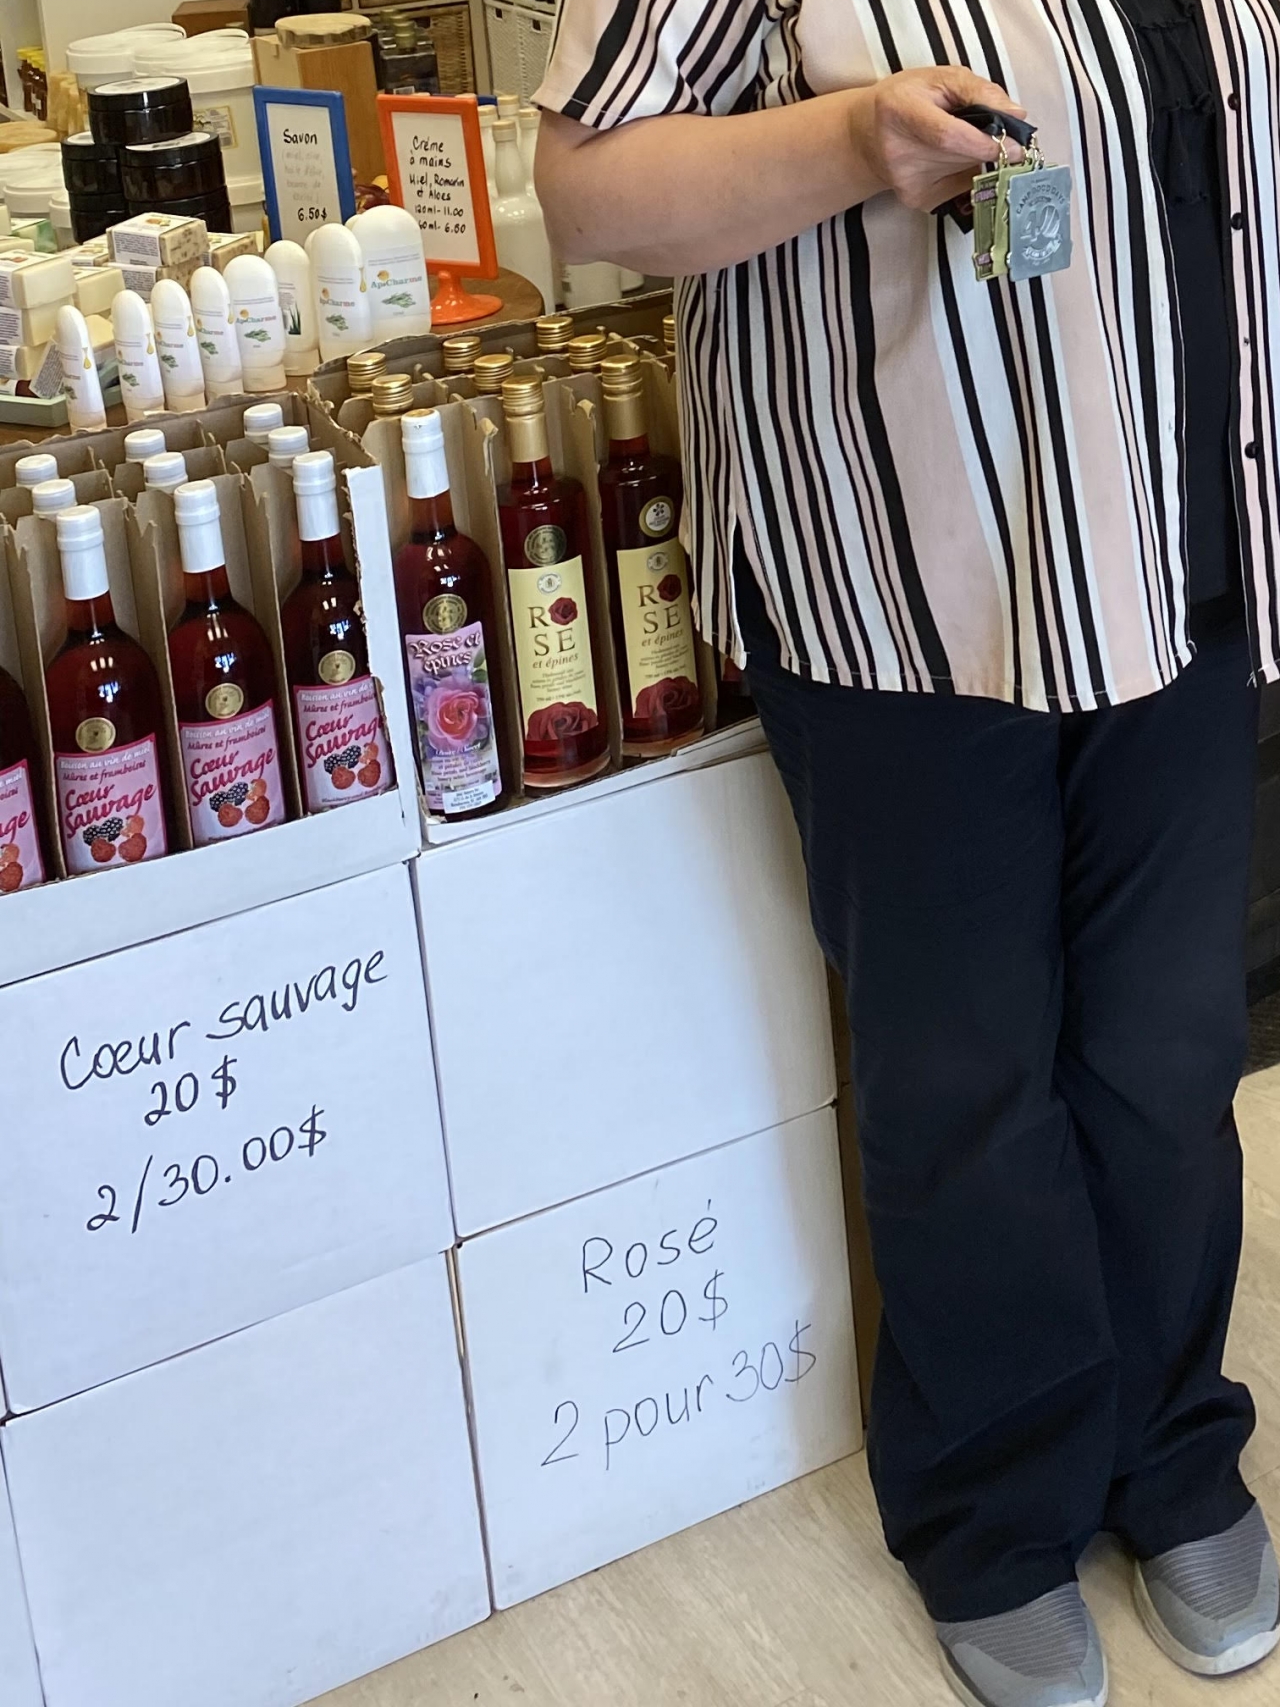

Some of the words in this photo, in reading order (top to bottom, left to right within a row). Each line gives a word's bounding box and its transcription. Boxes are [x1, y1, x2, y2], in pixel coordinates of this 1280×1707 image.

[283, 128, 318, 145] Savon
[420, 156, 452, 168] mains
[297, 207, 328, 222] 6.50$
[410, 634, 462, 659] Rose
[641, 636, 651, 647] et
[654, 629, 684, 647] épines
[532, 659, 543, 670] et
[546, 652, 579, 670] épines
[190, 747, 277, 807] Sauvage
[65, 783, 156, 840] Sauvage
[205, 950, 388, 1040] sauvage
[582, 1199, 718, 1293] Rosé
[611, 1270, 730, 1355] 20$
[539, 1400, 581, 1467] 2
[602, 1370, 713, 1472] pour
[725, 1319, 817, 1404] 30$
